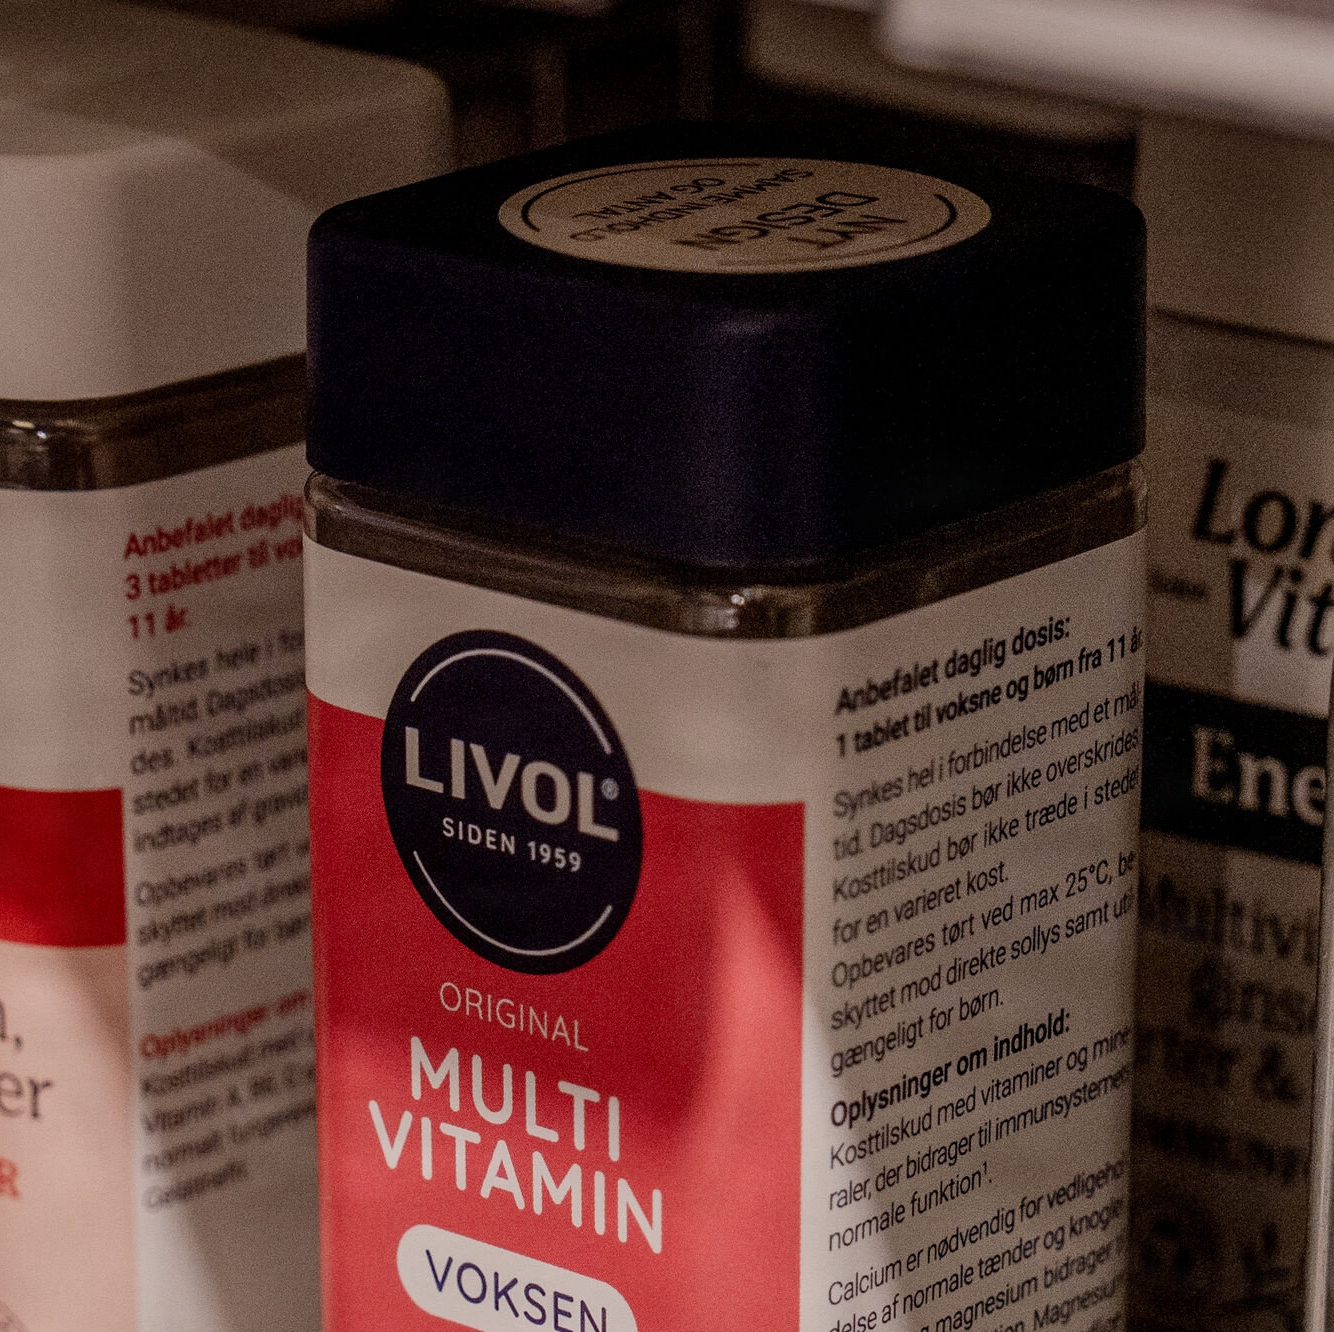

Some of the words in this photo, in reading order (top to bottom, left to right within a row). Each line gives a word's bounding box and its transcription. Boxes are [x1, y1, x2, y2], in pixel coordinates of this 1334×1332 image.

[568, 202, 714, 243] INDHOLD
[572, 191, 677, 220] ANTAL
[669, 176, 727, 195] OG
[671, 190, 881, 252] DESIGN
[701, 167, 814, 204] SAMME
[786, 213, 909, 251] NYT
[126, 573, 141, 601] 3
[128, 612, 156, 640] 11
[835, 660, 940, 715] Anbefalet
[945, 640, 1006, 679] daglig
[1012, 617, 1071, 656] dosis:
[853, 714, 910, 754] tablet
[914, 703, 933, 733] til
[935, 685, 1002, 725] voksne
[1033, 658, 1074, 691] børn
[1078, 647, 1103, 674] fra
[1107, 633, 1126, 662] 11
[833, 776, 905, 822] Synkes
[907, 759, 935, 793] hel
[949, 725, 1048, 777] forbindelse
[1050, 702, 1091, 741] med
[1093, 697, 1111, 724] et
[833, 828, 864, 860] tid.
[870, 796, 967, 850] Dagsdosis
[972, 781, 1003, 812] bør
[1006, 768, 1042, 802] ikke
[1046, 726, 1140, 783] overskrides
[1190, 725, 1327, 827] Ene
[442, 817, 516, 854] SIDEN
[526, 841, 582, 872] 1959
[832, 846, 942, 903] Kosttilskud
[947, 831, 979, 862] bør
[983, 816, 1020, 850] ikke
[1025, 793, 1078, 833] træde
[831, 931, 936, 990] Opbevares
[942, 914, 976, 948] tørt
[981, 896, 1014, 931] ved
[1020, 883, 1059, 917] max
[1065, 859, 1113, 899] 25°C,
[832, 919, 861, 946] for
[867, 909, 890, 935] en
[894, 879, 963, 925] varieret
[967, 861, 1009, 896] kost.
[831, 987, 896, 1032] skyttet
[901, 965, 942, 1005] mod
[946, 946, 1007, 987] direkte
[1011, 923, 1061, 962] sollys
[1065, 901, 1110, 940] samt
[439, 982, 589, 1052] ORIGINAL
[831, 1015, 924, 1078] gængeligt
[929, 1006, 955, 1034] for
[959, 988, 1004, 1023] børn.
[411, 1036, 620, 1162] MULTI
[831, 1062, 953, 1130] Oplysninger
[957, 1048, 988, 1076] om
[993, 1008, 1070, 1063] indhold:
[831, 1106, 932, 1170] Kosttilskud
[937, 1087, 977, 1127] med
[981, 1055, 1064, 1106] vitaminer
[369, 1100, 663, 1254] VITAMIN
[829, 1179, 873, 1212] raler,
[875, 1160, 903, 1194] der
[906, 1131, 976, 1180] bidrager
[977, 1120, 993, 1149] til
[828, 1259, 903, 1307] Calcium
[906, 1247, 925, 1273] er
[927, 1207, 1016, 1264] nødvendig
[1019, 1194, 1044, 1222] for
[829, 1202, 906, 1252] normale
[1043, 1242, 1113, 1290] bidrager
[881, 1292, 900, 1324] af
[903, 1264, 975, 1315] normale
[977, 1236, 1041, 1281] tænder
